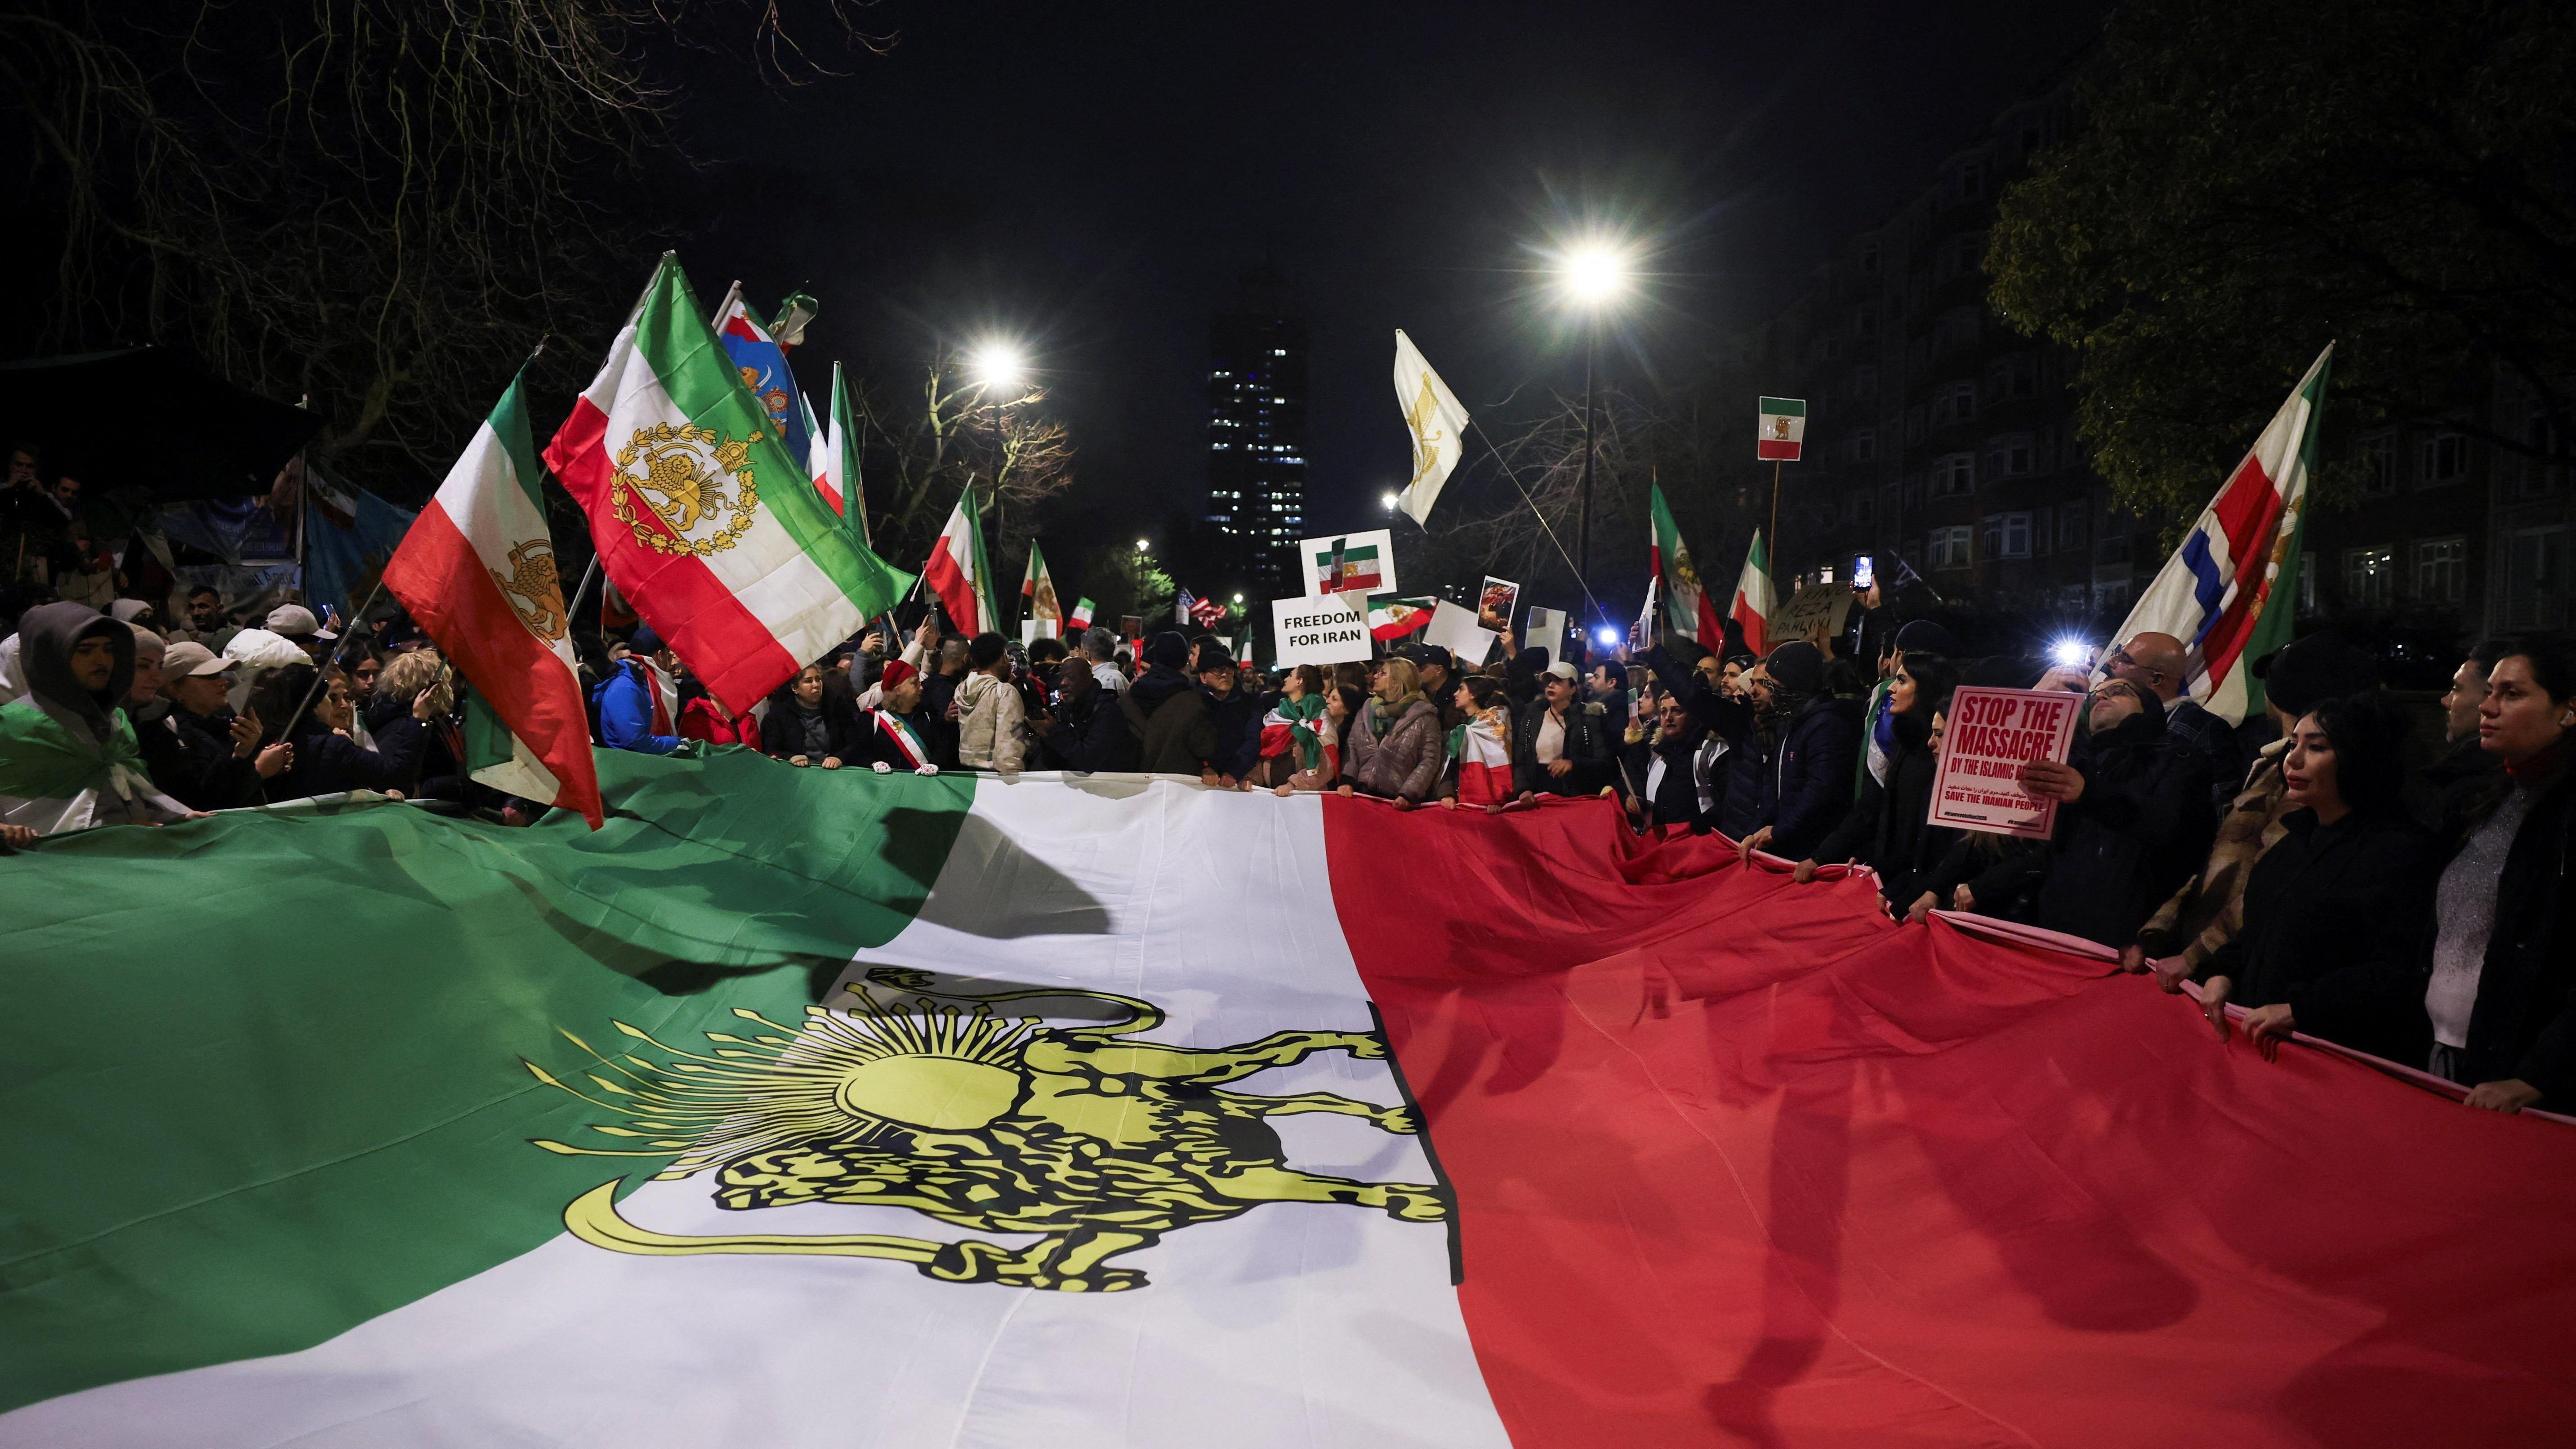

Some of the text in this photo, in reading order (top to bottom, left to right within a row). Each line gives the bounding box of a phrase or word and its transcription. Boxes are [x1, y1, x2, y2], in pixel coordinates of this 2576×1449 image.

[1786, 602, 1832, 617] REZA
[1284, 611, 1360, 629] FREEDOM
[1290, 629, 1361, 646] FOR IRAN
[1961, 697, 2063, 731] STOP THE
[1956, 725, 2055, 761] MASSACRE
[1951, 758, 1962, 773] BY
[1963, 759, 1979, 775] THE
[1980, 762, 2014, 779] ISLAMIC
[1945, 791, 2044, 811] SAVE THE IRANIAN PEOPLE
